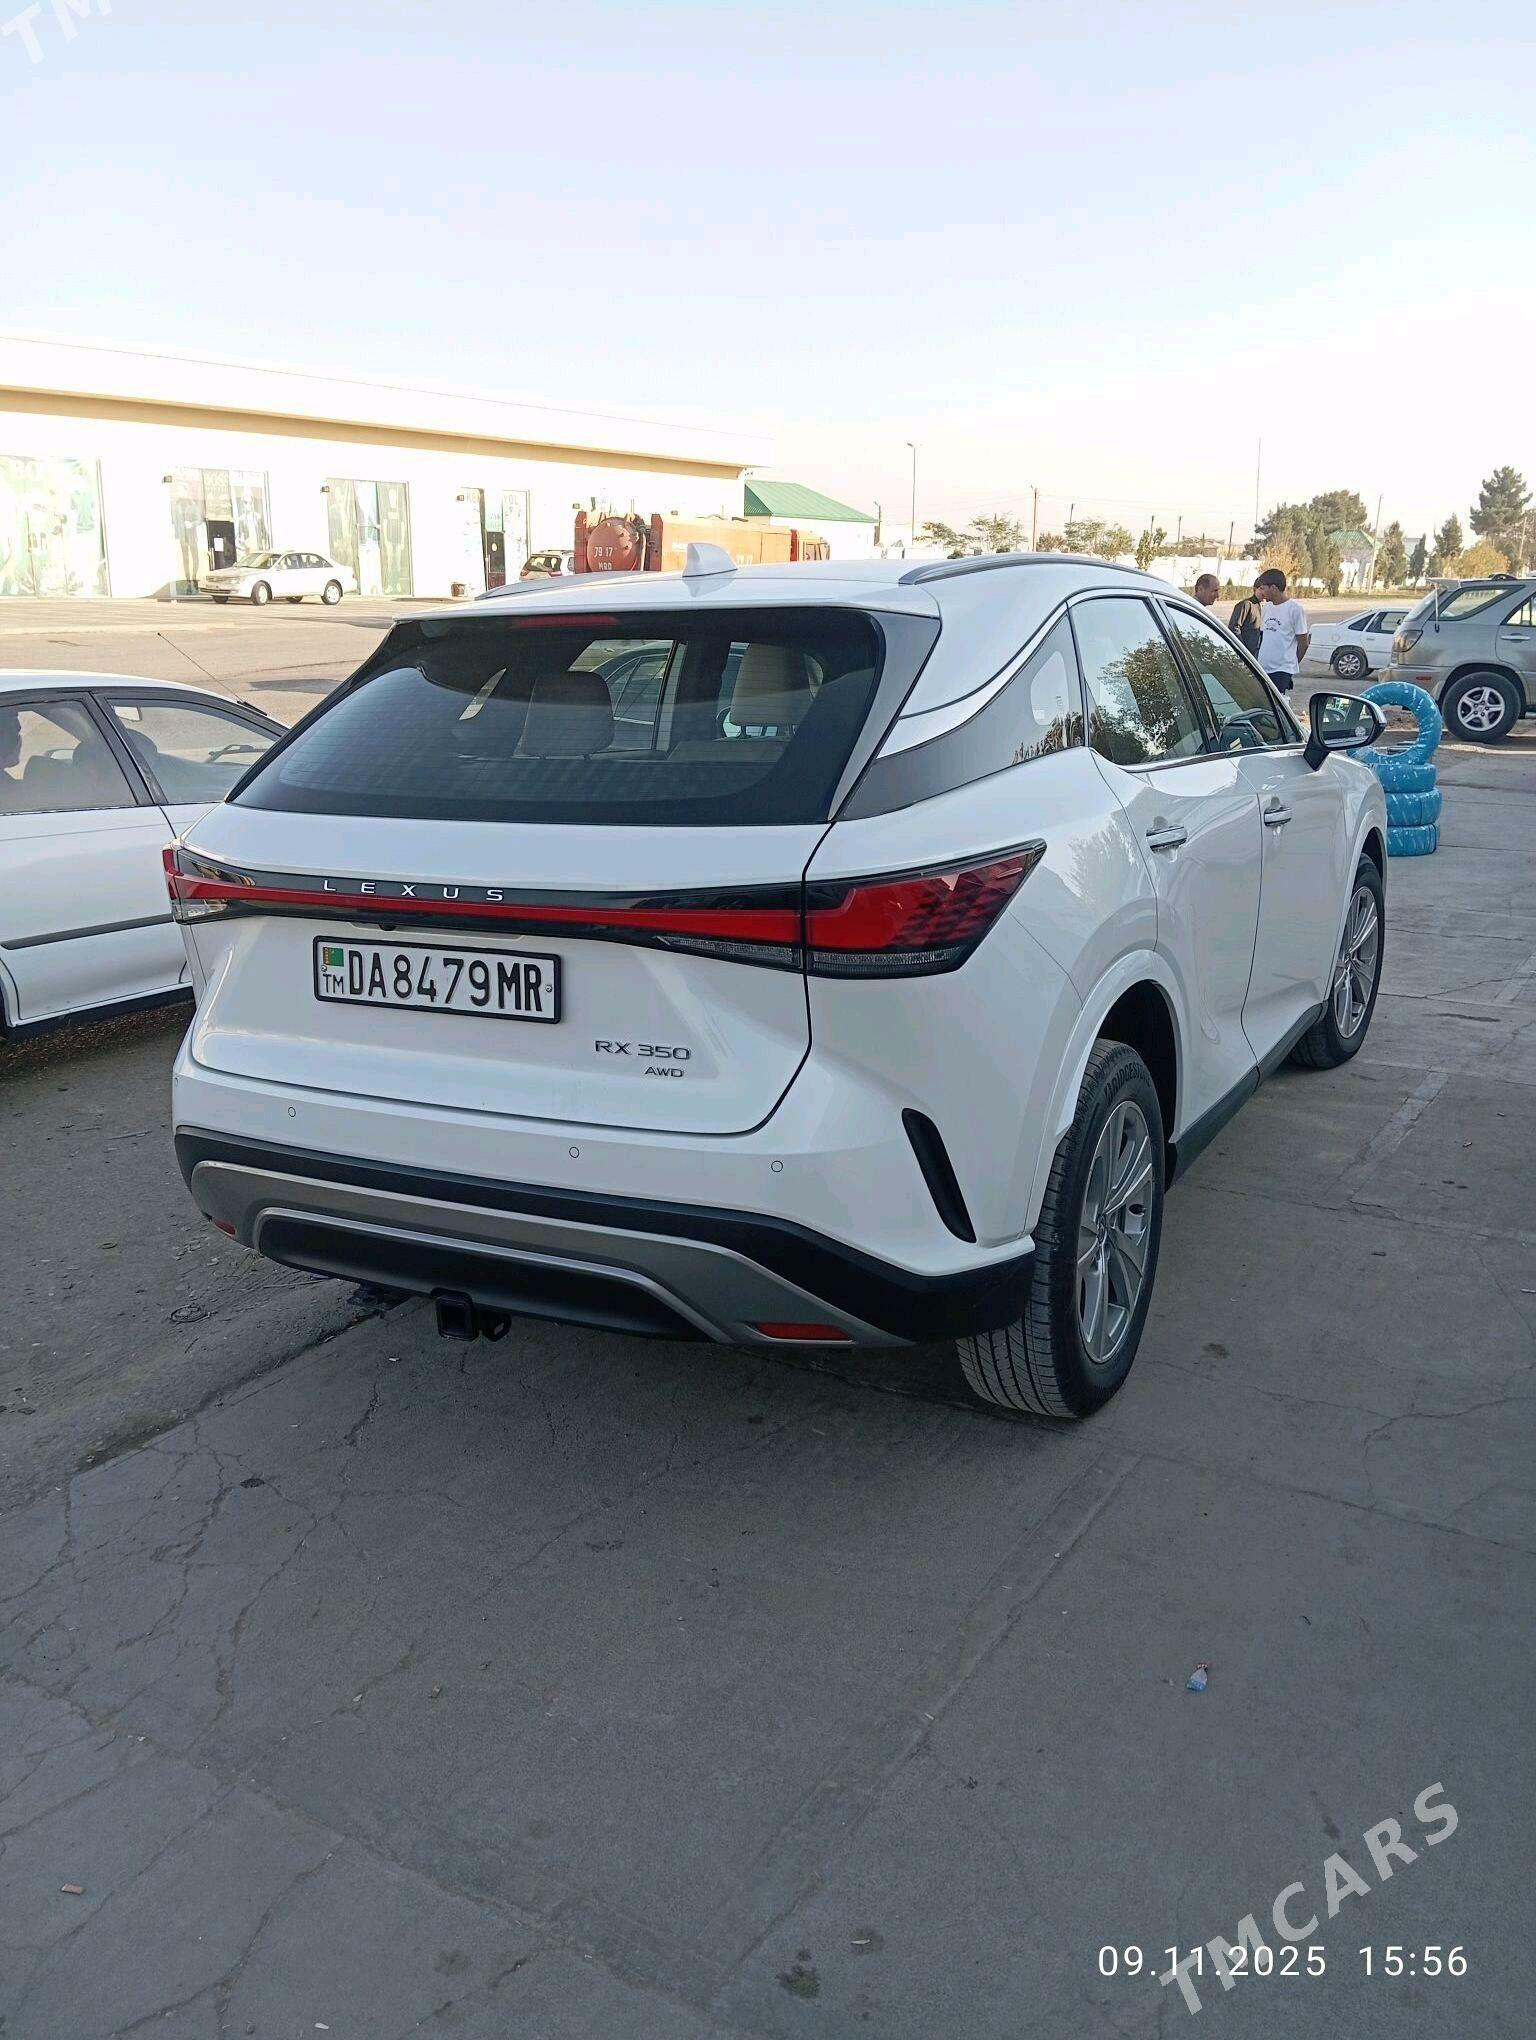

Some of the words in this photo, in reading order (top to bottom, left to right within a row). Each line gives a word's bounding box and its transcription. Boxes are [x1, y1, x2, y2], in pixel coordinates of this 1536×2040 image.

[323, 879, 504, 901] LEXUS
[323, 973, 344, 994] TM
[349, 950, 543, 1012] DA8479MR
[595, 1040, 630, 1055] RX
[637, 1044, 691, 1060] 350
[644, 1066, 684, 1078] AWD
